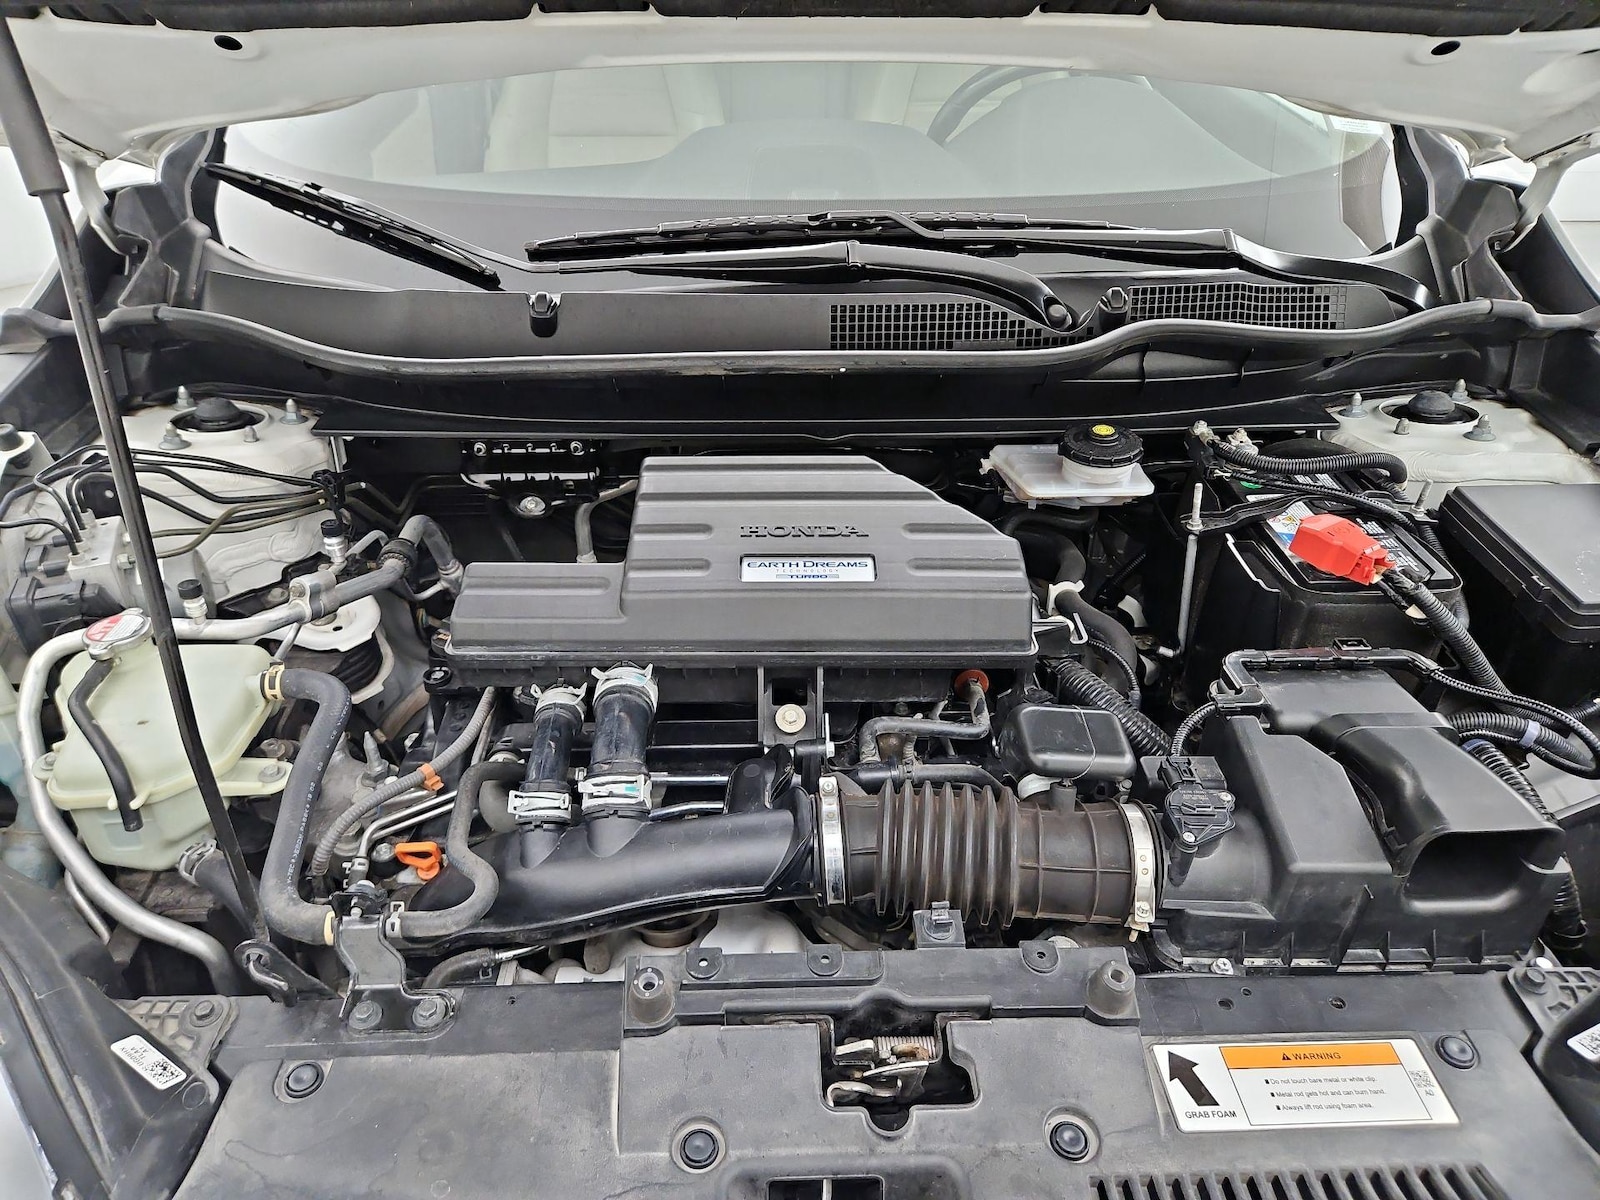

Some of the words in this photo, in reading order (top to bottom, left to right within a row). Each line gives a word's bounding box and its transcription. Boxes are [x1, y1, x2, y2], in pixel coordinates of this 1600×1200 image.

[740, 525, 869, 538] HONDA
[803, 560, 868, 568] DREAMS
[1292, 1051, 1342, 1061] WARNING
[1325, 1102, 1342, 1110] using
[1185, 1111, 1211, 1119] GRAB
[1212, 1110, 1237, 1118] FOAM
